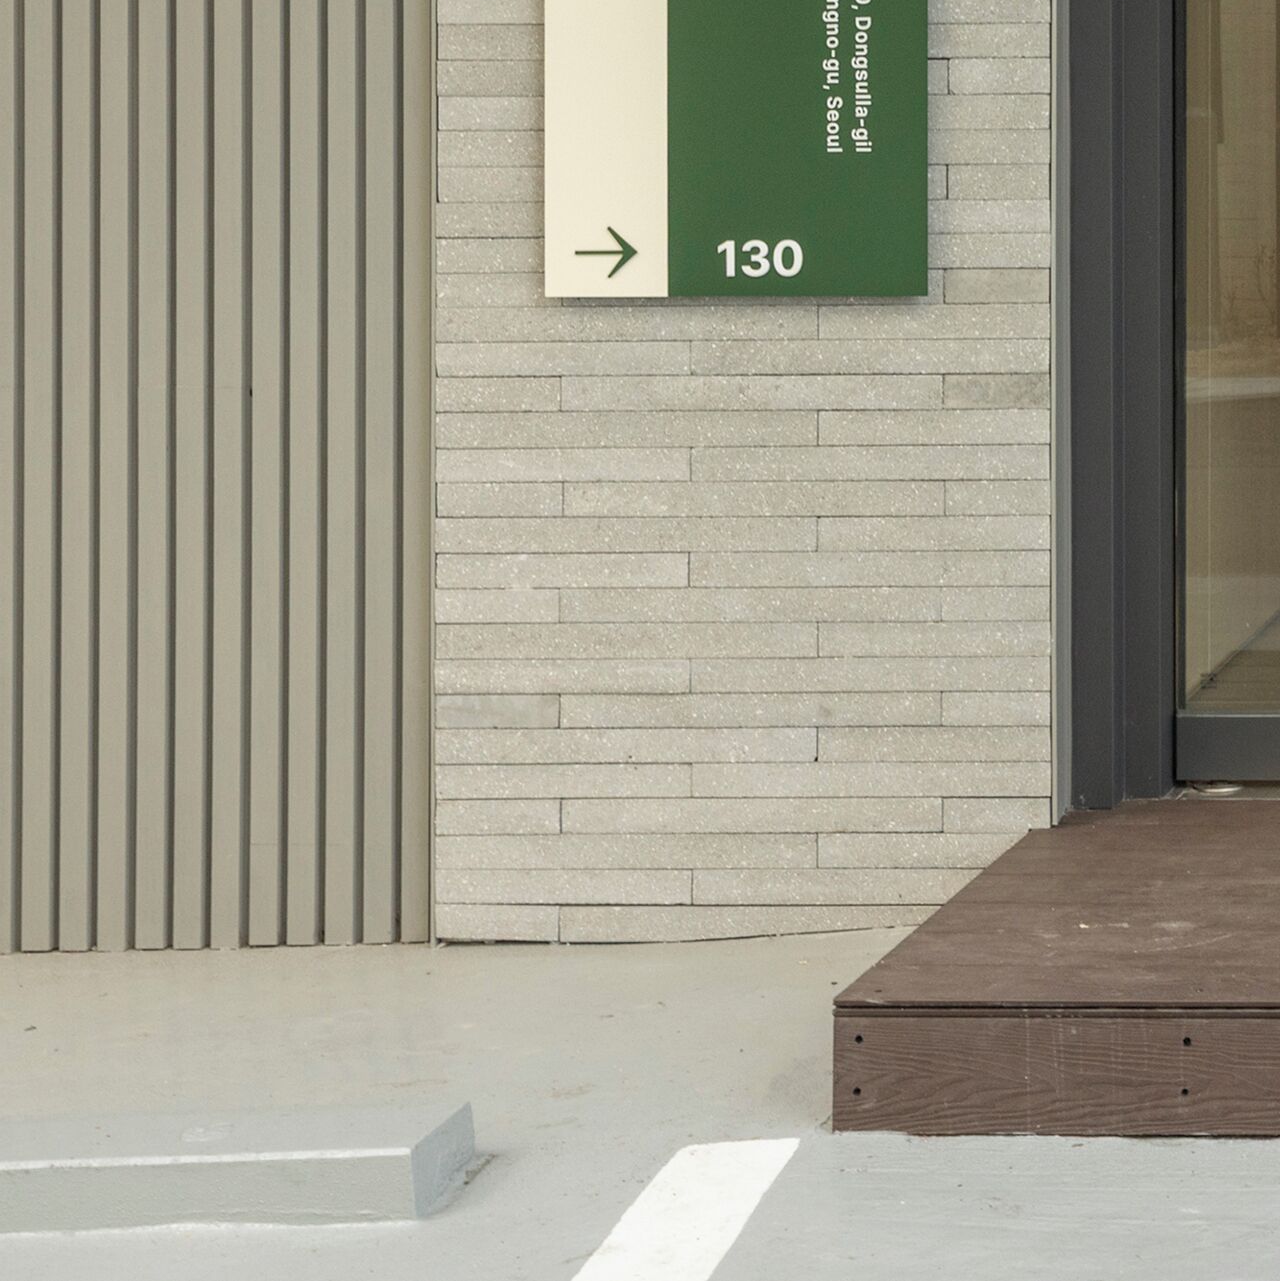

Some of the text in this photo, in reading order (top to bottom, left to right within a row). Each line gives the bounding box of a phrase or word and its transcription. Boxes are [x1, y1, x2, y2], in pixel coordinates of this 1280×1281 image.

[850, 16, 872, 153] Dongsulla-gil
[825, 95, 844, 153] Seoul
[717, 238, 804, 278] 130
